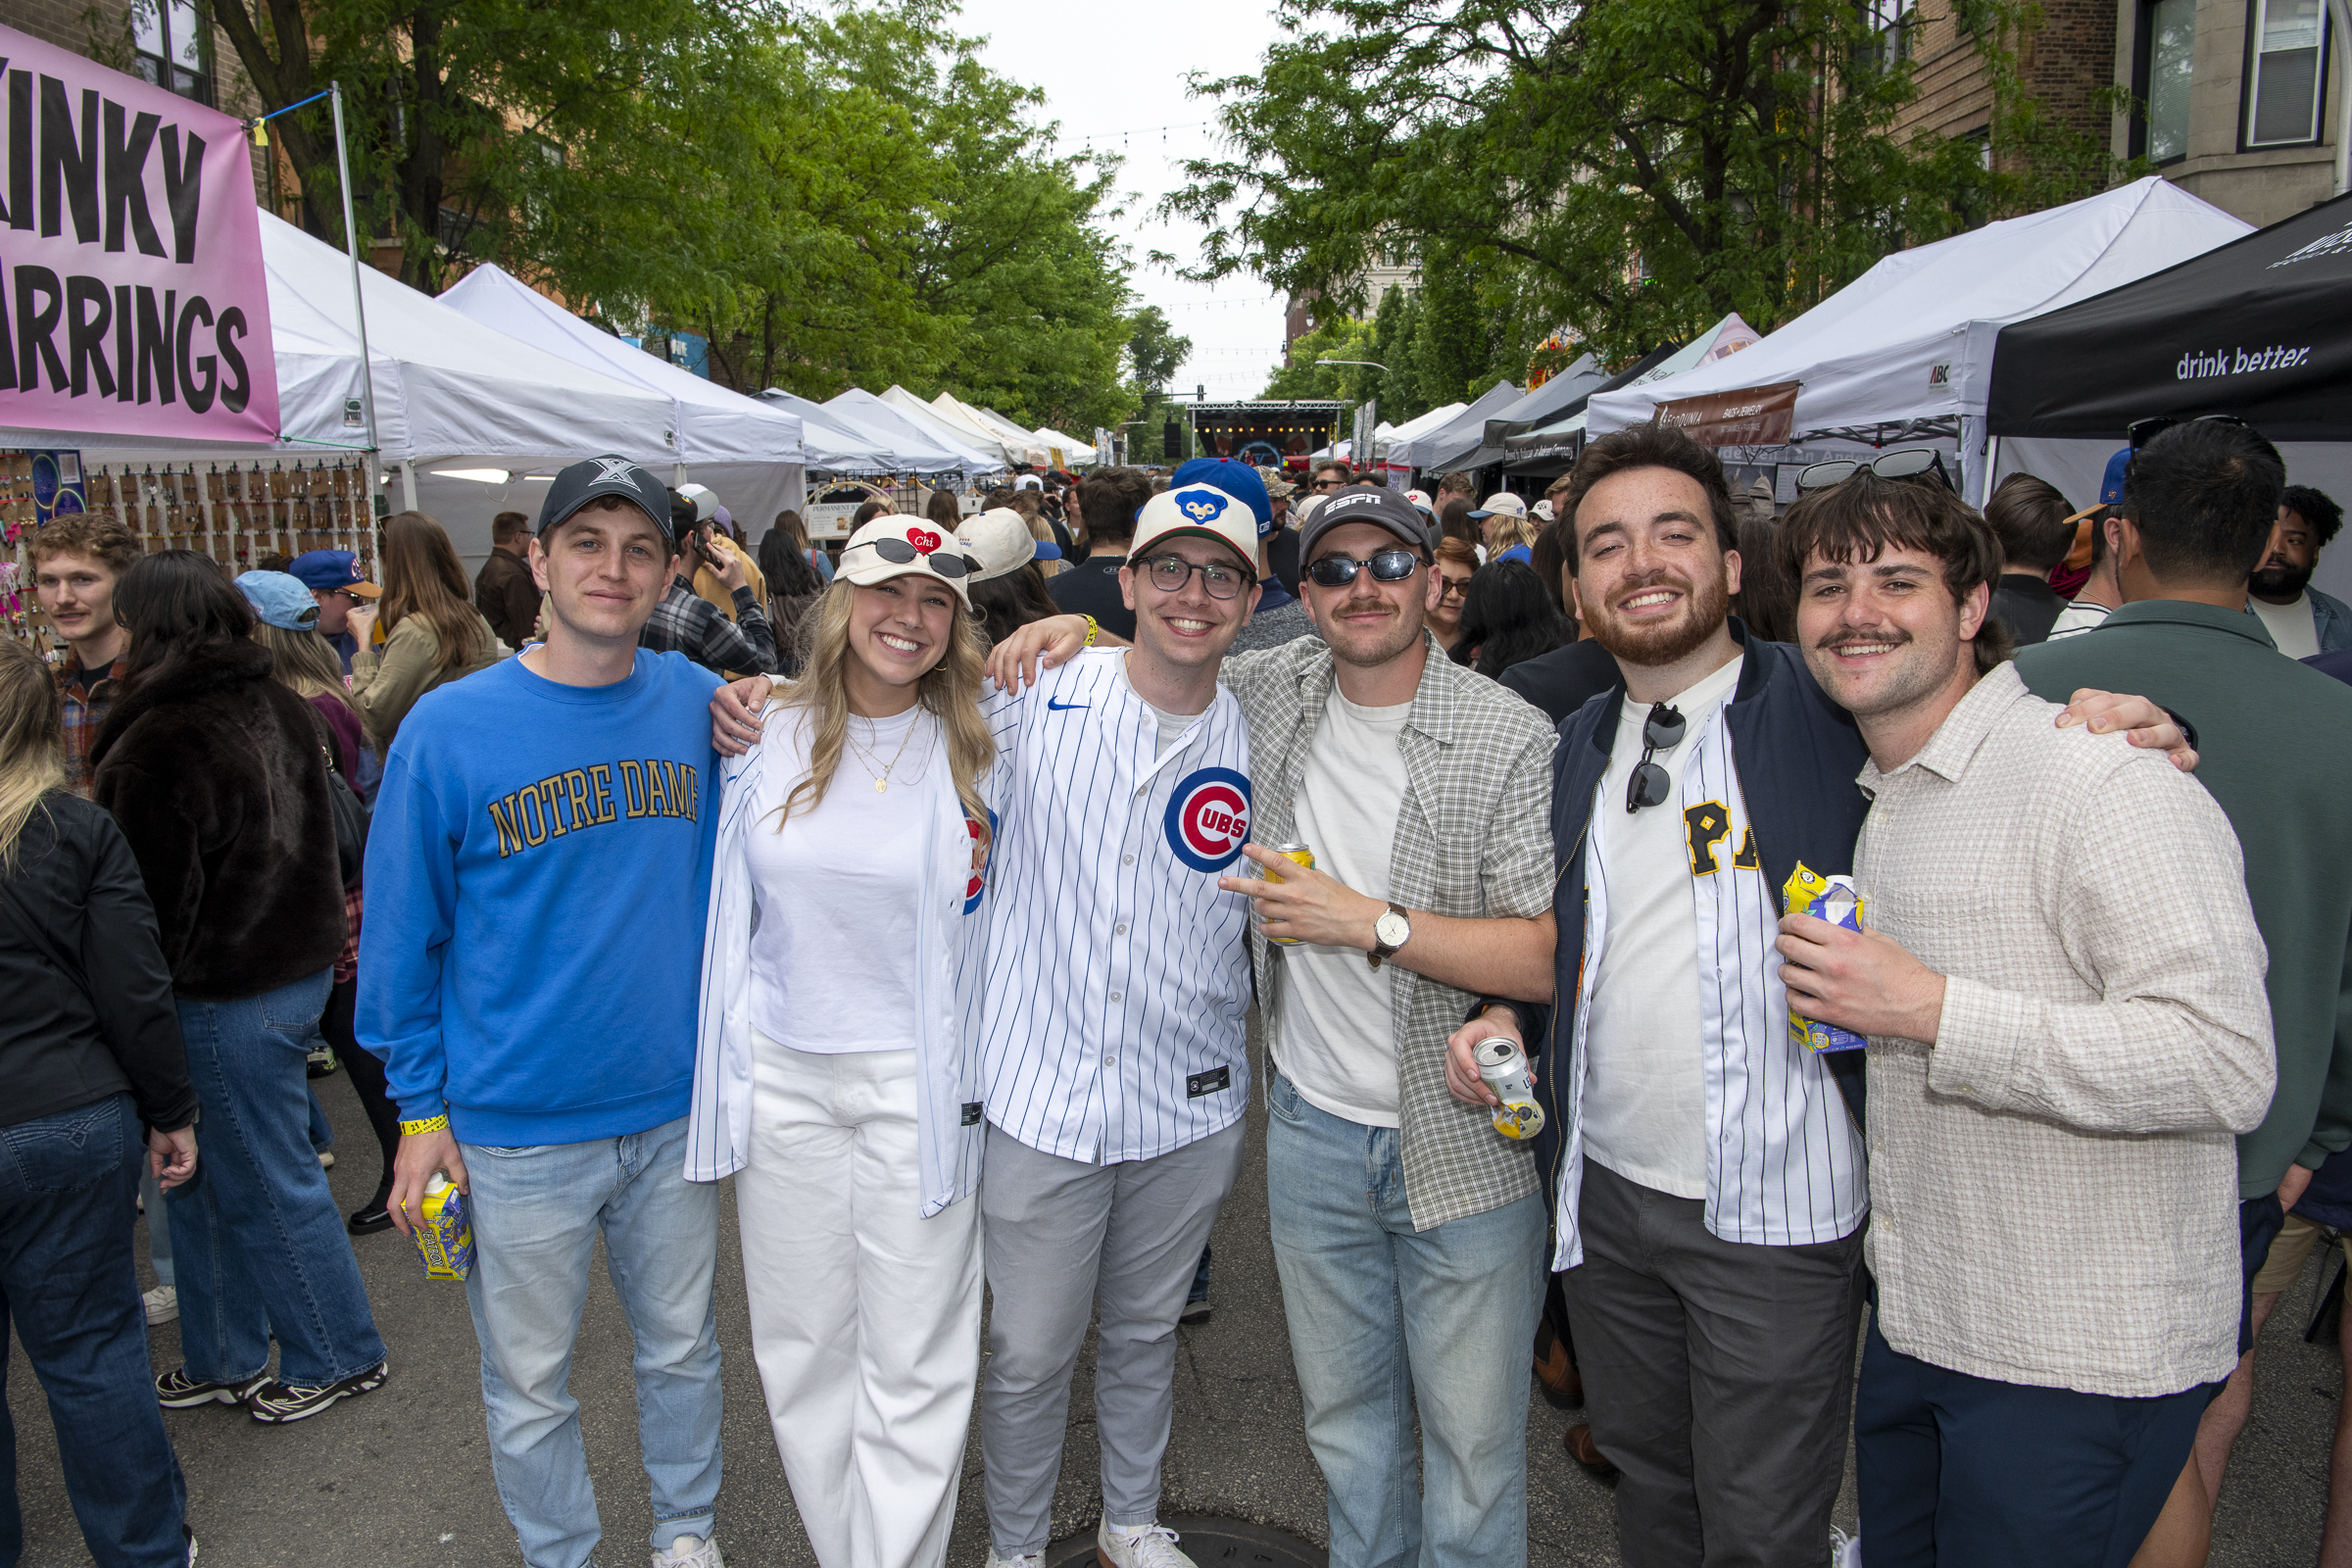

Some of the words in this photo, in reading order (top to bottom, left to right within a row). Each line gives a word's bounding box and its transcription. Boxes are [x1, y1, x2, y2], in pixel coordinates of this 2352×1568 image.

[0, 57, 207, 264] INKY
[1930, 364, 1950, 384] ABC
[2177, 349, 2230, 380] drink
[2231, 344, 2311, 374] better.
[1324, 493, 1382, 516] ESPN
[914, 535, 934, 548] Chi
[488, 764, 617, 859] NOTRE
[1184, 786, 1248, 856] CUBS
